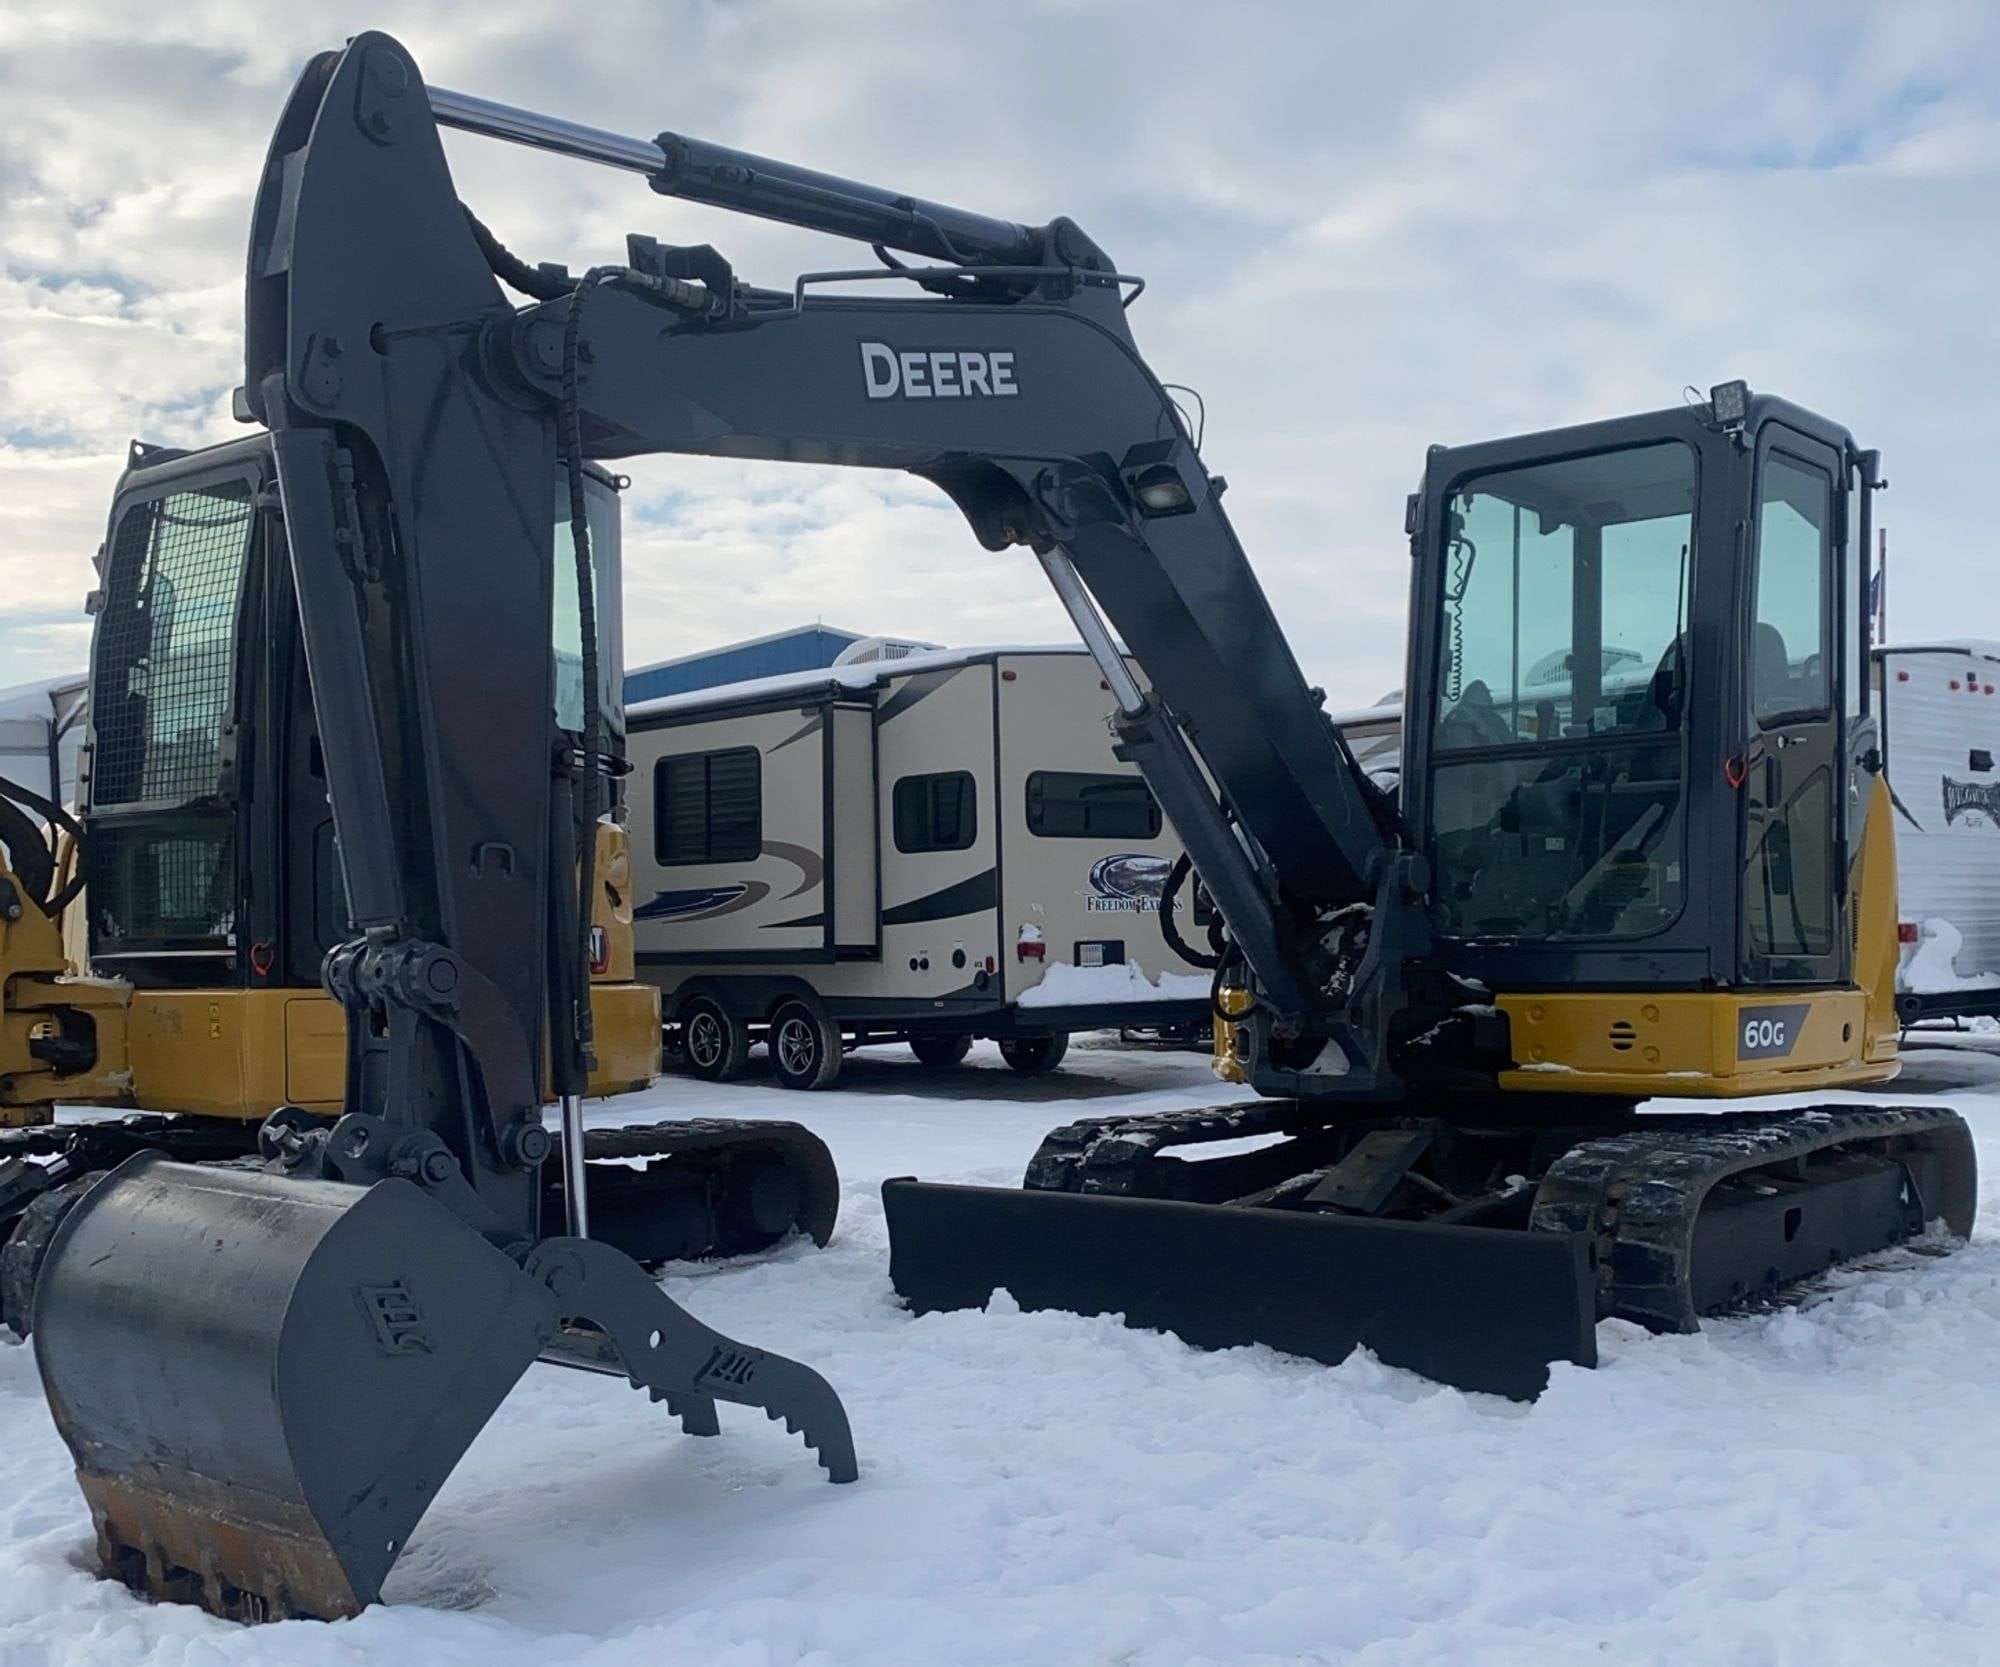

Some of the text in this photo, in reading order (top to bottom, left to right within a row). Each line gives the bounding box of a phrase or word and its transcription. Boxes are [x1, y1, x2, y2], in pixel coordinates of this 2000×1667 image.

[861, 343, 1018, 398] DEERE
[1087, 896, 1184, 911] FREEDOM EXPSS
[1745, 1020, 1785, 1048] 60G
